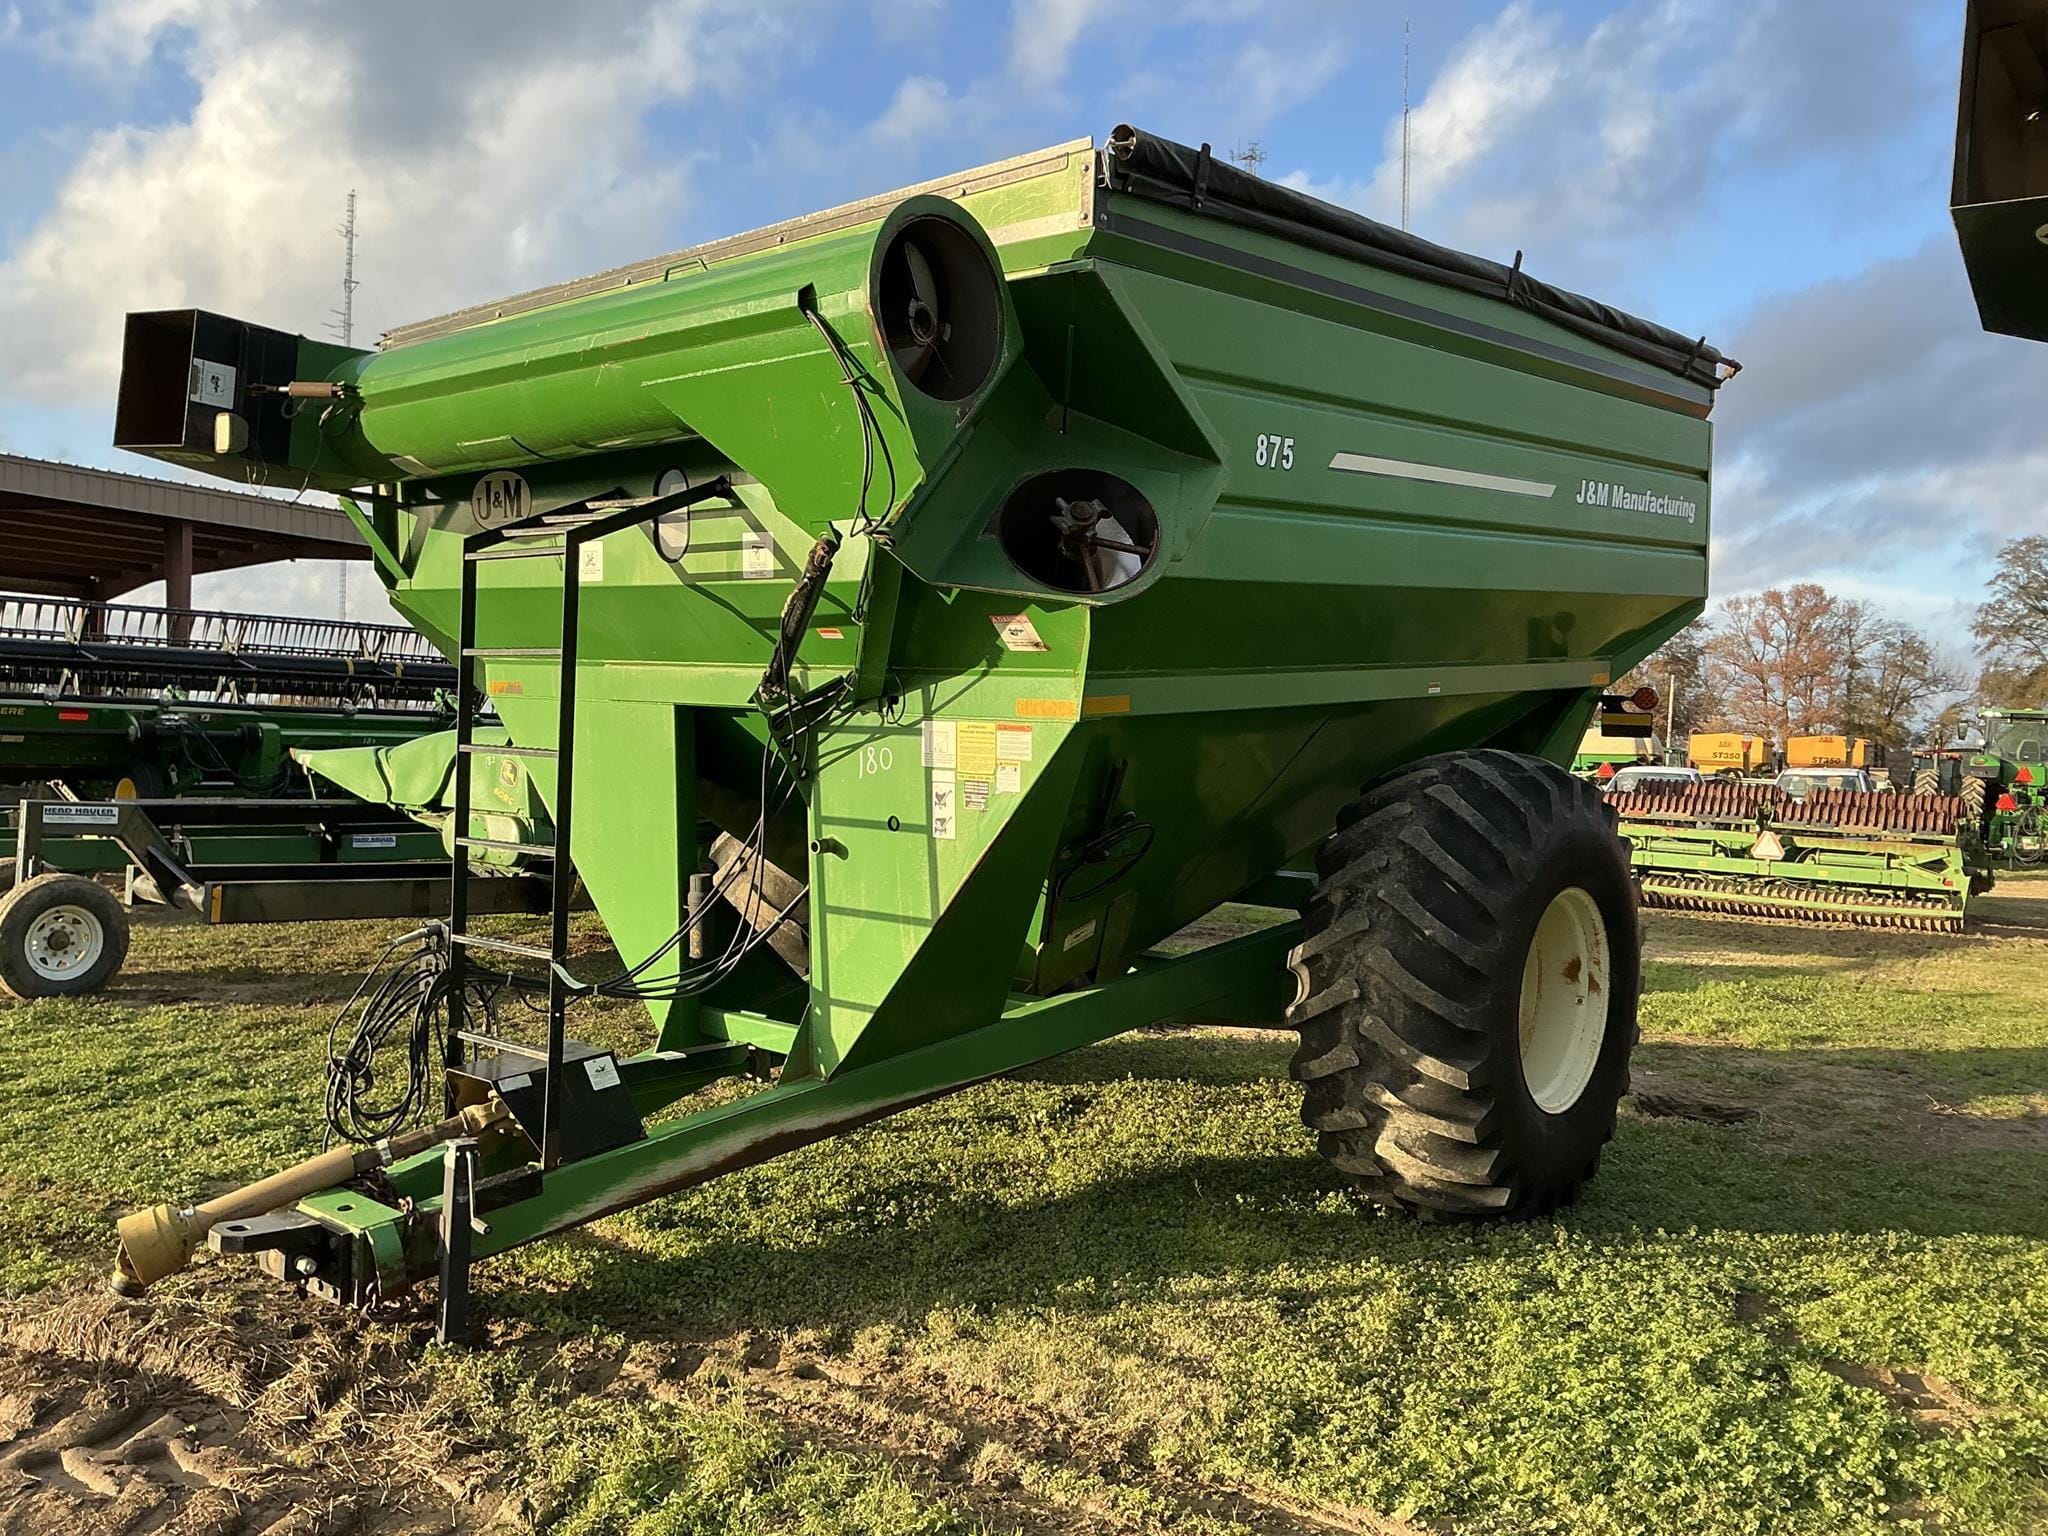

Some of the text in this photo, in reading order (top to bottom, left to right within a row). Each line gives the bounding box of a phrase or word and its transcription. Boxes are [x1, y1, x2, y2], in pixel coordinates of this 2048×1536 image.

[1255, 433, 1295, 471] 875
[476, 479, 523, 520] J&M
[1576, 479, 1696, 524] J&M Manufacturing
[859, 746, 893, 780] 180
[1711, 751, 1741, 760] ST350
[1811, 756, 1841, 764] ST350
[44, 807, 114, 816] HEAD HAULER
